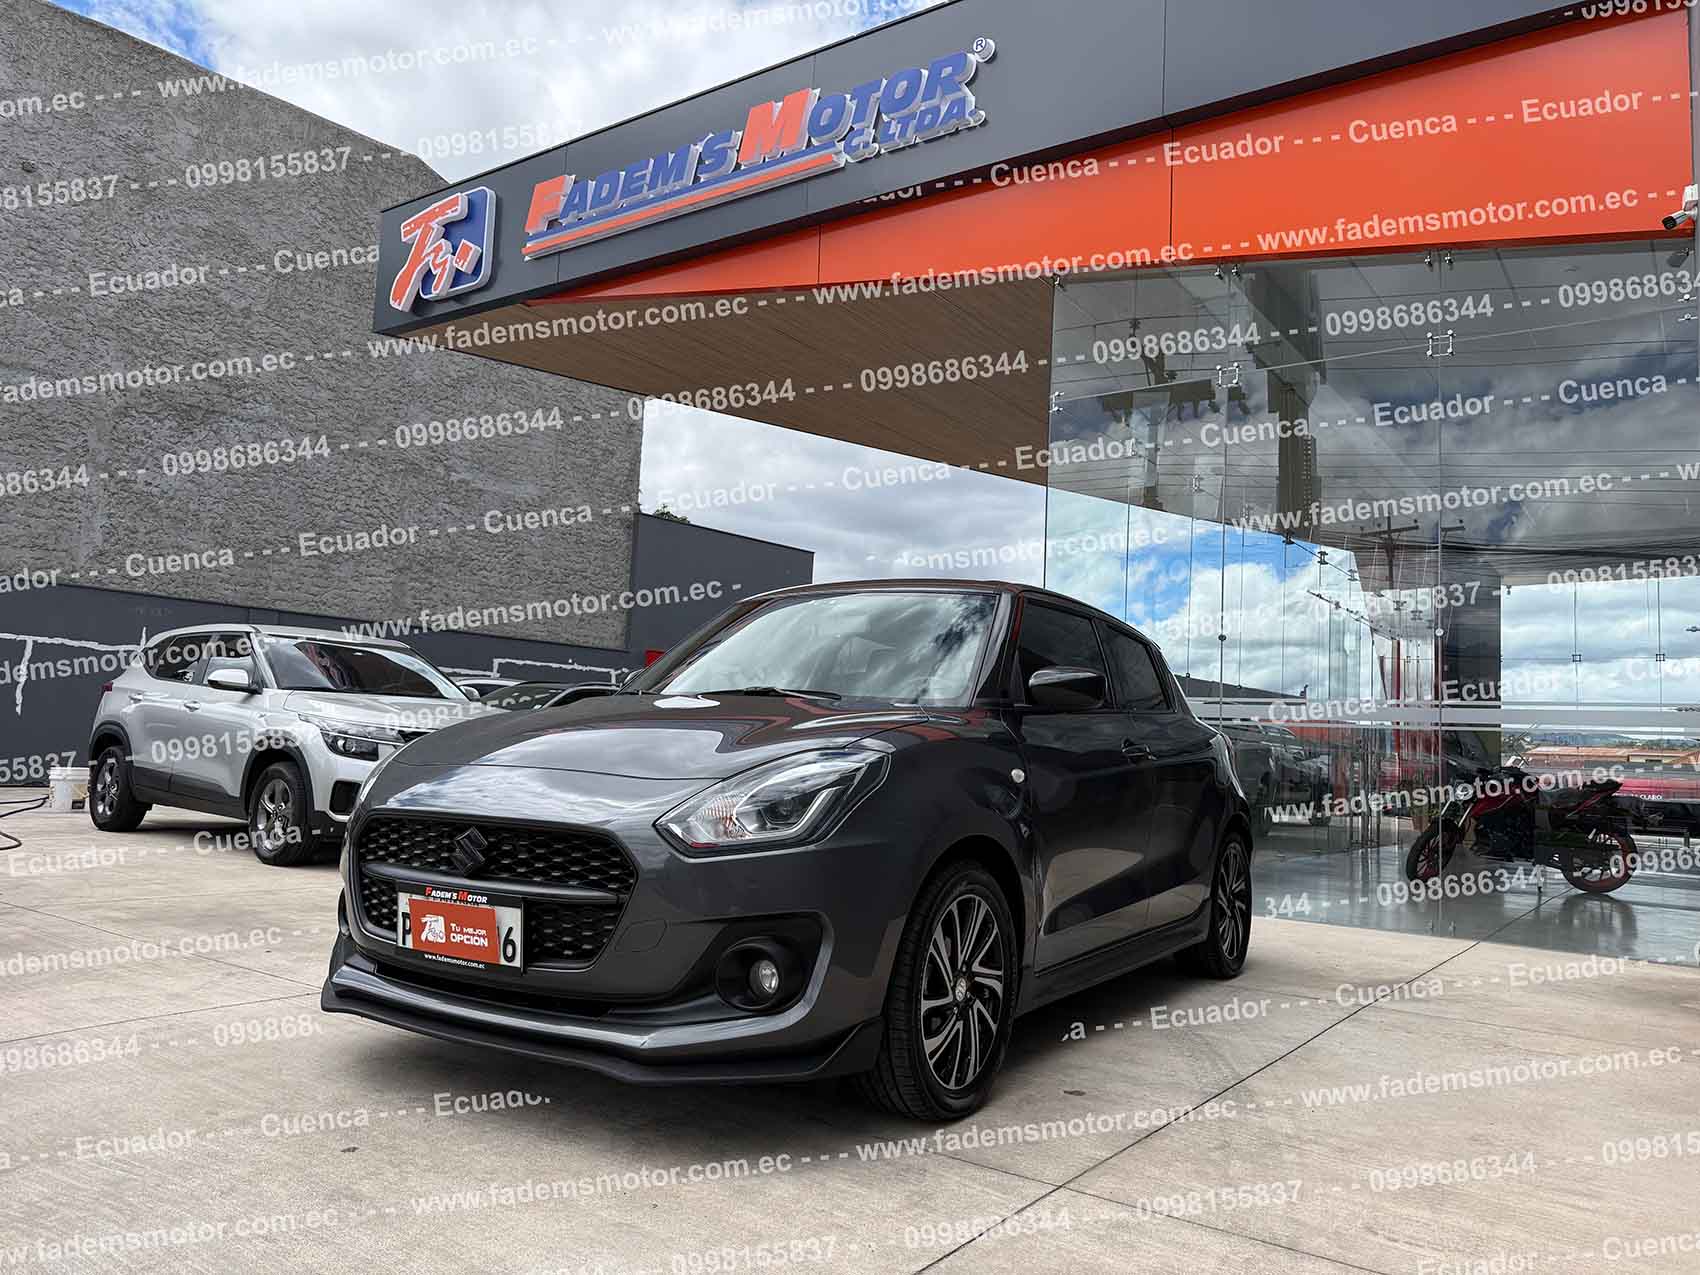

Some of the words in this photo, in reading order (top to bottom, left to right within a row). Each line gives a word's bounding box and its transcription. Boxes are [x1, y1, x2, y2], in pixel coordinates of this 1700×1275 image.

[738, 52, 976, 168] MOTOR
[457, 890, 488, 904] MOTOR
[502, 926, 517, 963] 6
